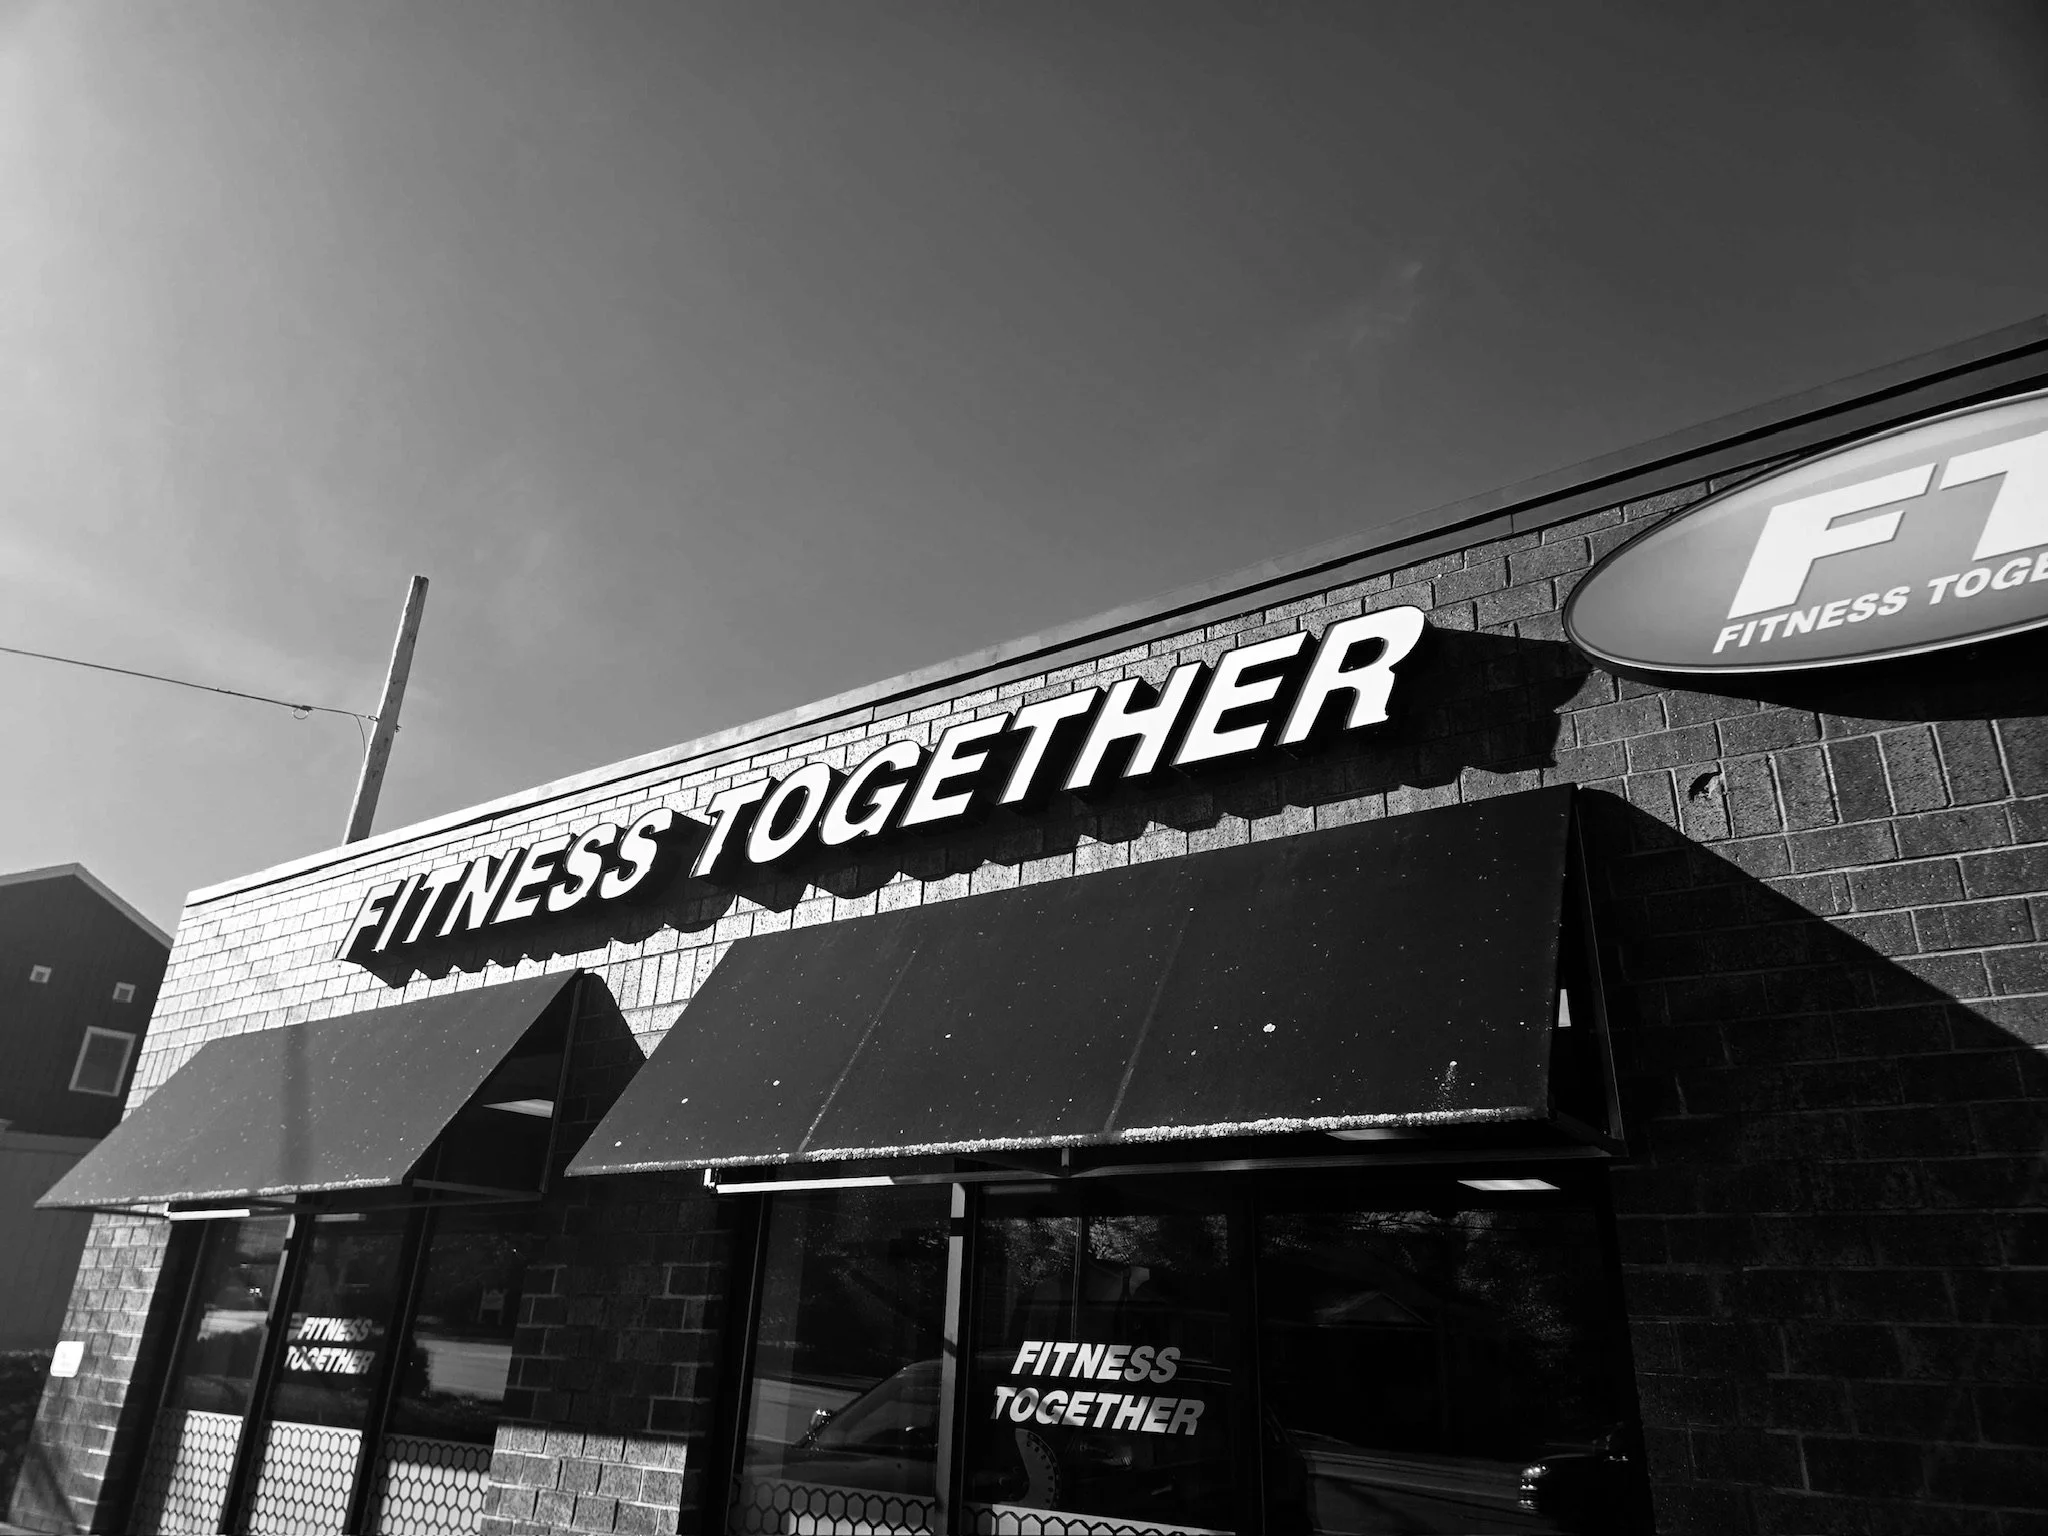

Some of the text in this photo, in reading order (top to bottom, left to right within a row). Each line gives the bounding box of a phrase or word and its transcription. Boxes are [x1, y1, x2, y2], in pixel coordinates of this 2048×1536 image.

[1728, 431, 2048, 620] FT
[1712, 585, 1911, 655] FITNESS
[337, 606, 1425, 960] FITNESS TOGETHER
[296, 1316, 373, 1343] FITNESS
[284, 1344, 376, 1375] TOGETHER
[1010, 1340, 1181, 1384] FITNESS
[991, 1385, 1206, 1436] TOGETHER
